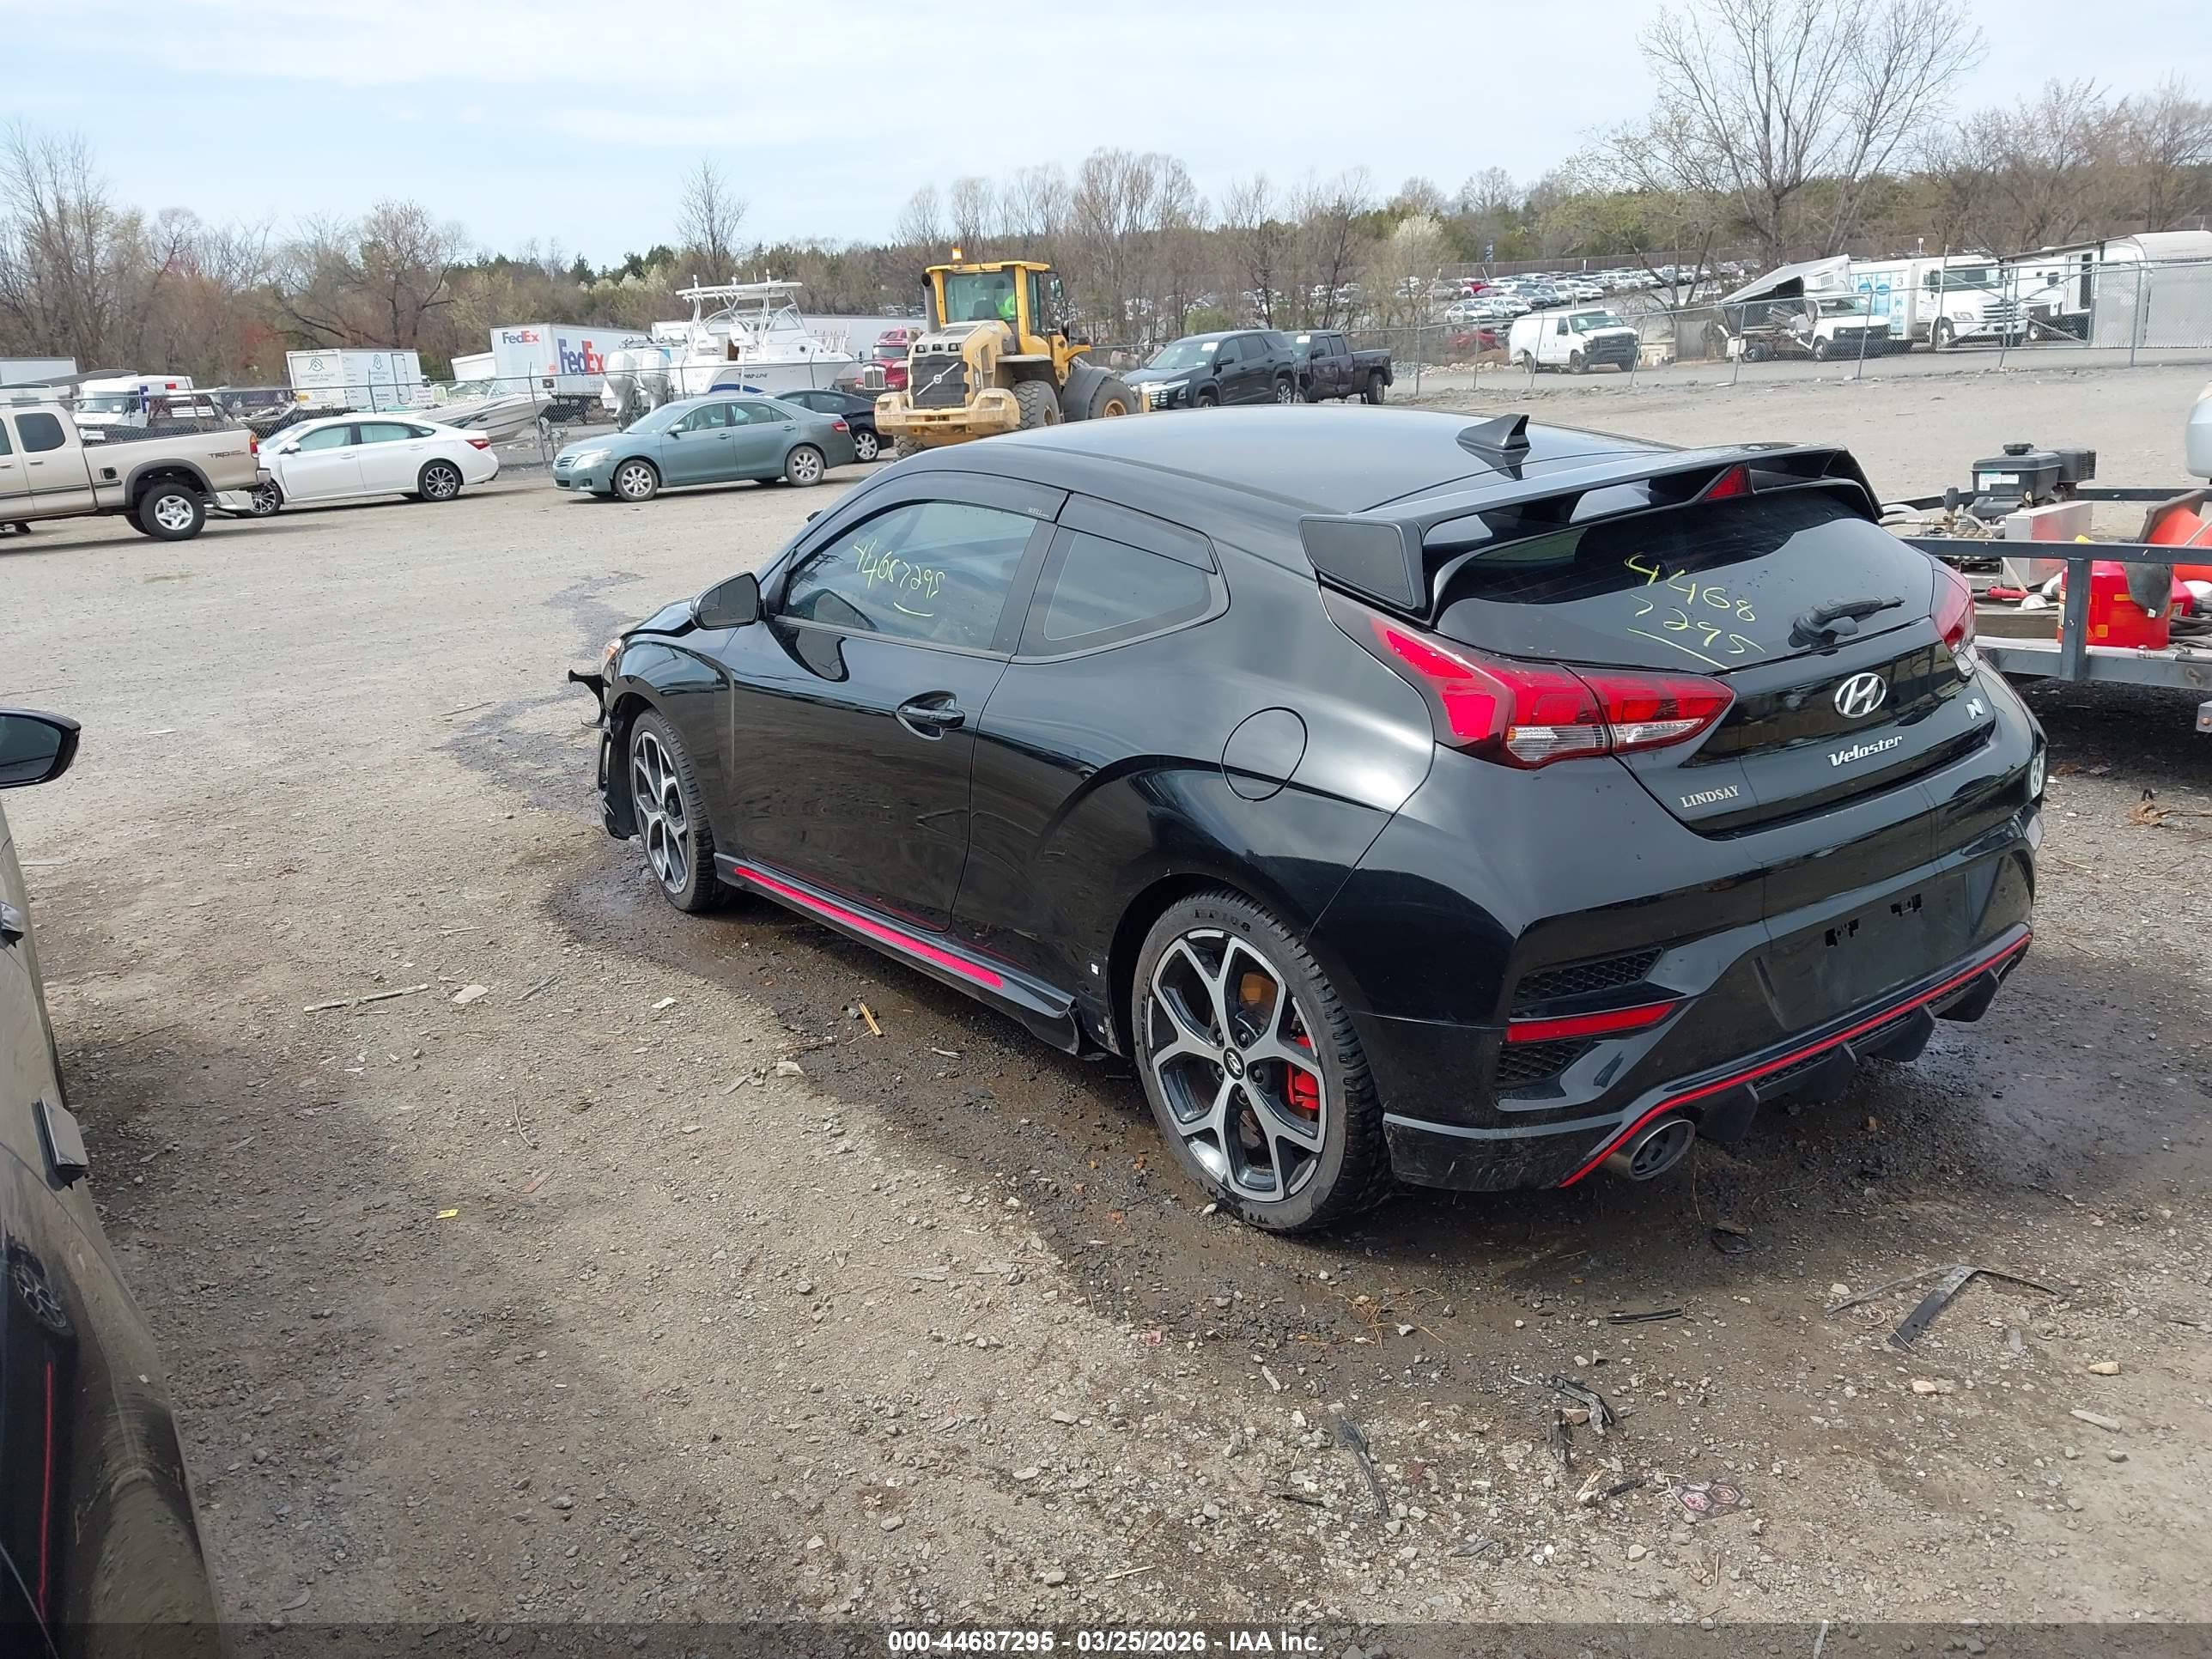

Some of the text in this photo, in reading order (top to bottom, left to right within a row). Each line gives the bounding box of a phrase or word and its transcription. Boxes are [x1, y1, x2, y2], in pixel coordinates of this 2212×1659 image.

[501, 331, 540, 343] FedEx
[557, 338, 605, 376] FedEx
[853, 538, 945, 599] 44687295
[1624, 552, 1756, 622] 4468
[1827, 736, 1904, 767] Veloster
[1680, 785, 1740, 808] LINDSAY
